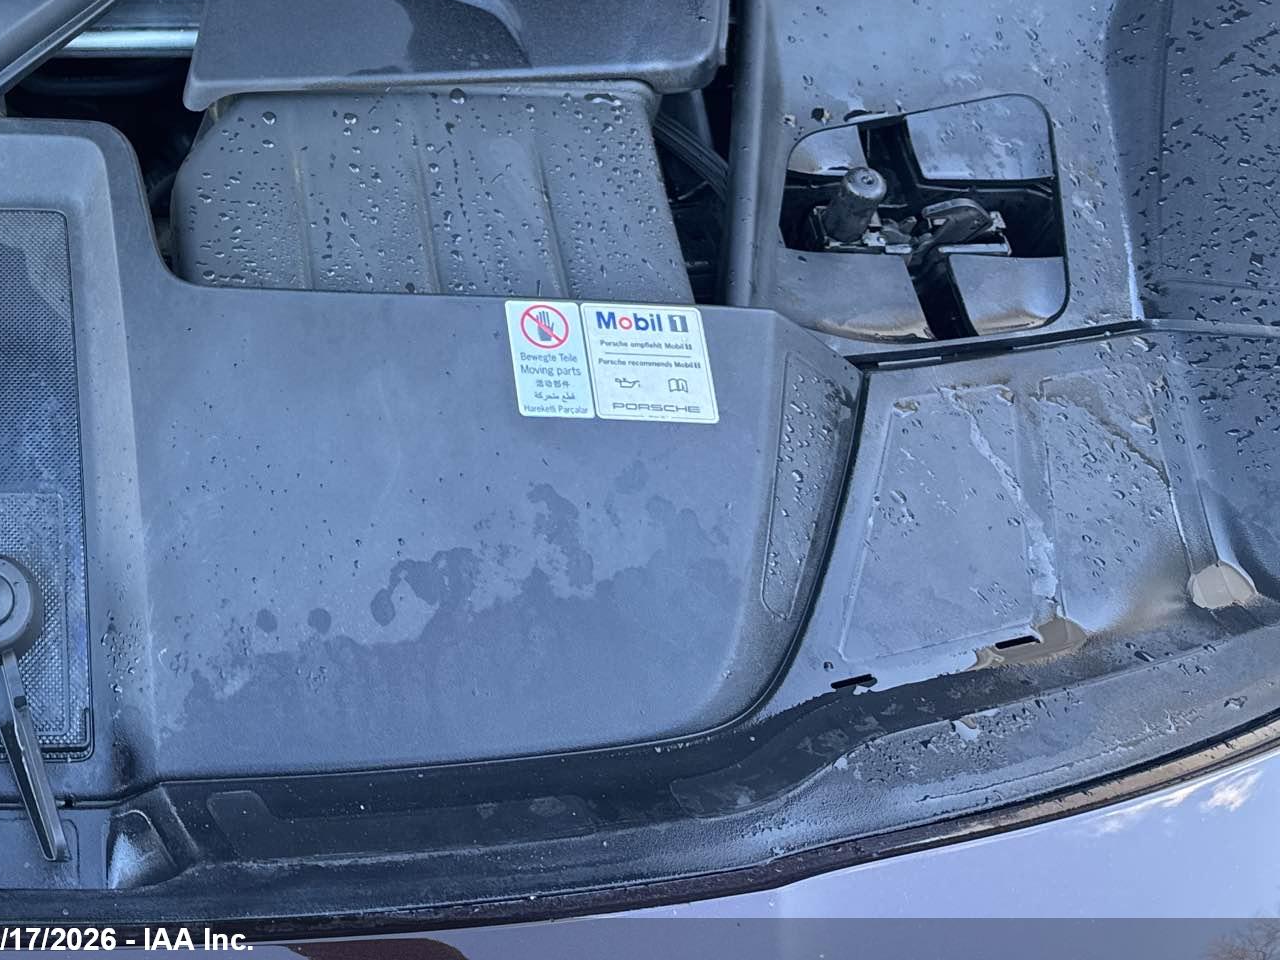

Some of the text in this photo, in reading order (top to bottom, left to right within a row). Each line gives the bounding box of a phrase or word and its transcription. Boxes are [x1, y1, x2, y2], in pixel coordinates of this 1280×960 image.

[595, 311, 688, 332] Mobil 1
[600, 339, 628, 347] Porsche
[520, 352, 577, 363] Bewegte Teile
[598, 357, 626, 365] Porsche
[628, 360, 672, 368] recommends
[520, 364, 582, 377] Moving parts
[613, 402, 701, 413] PORSCHE
